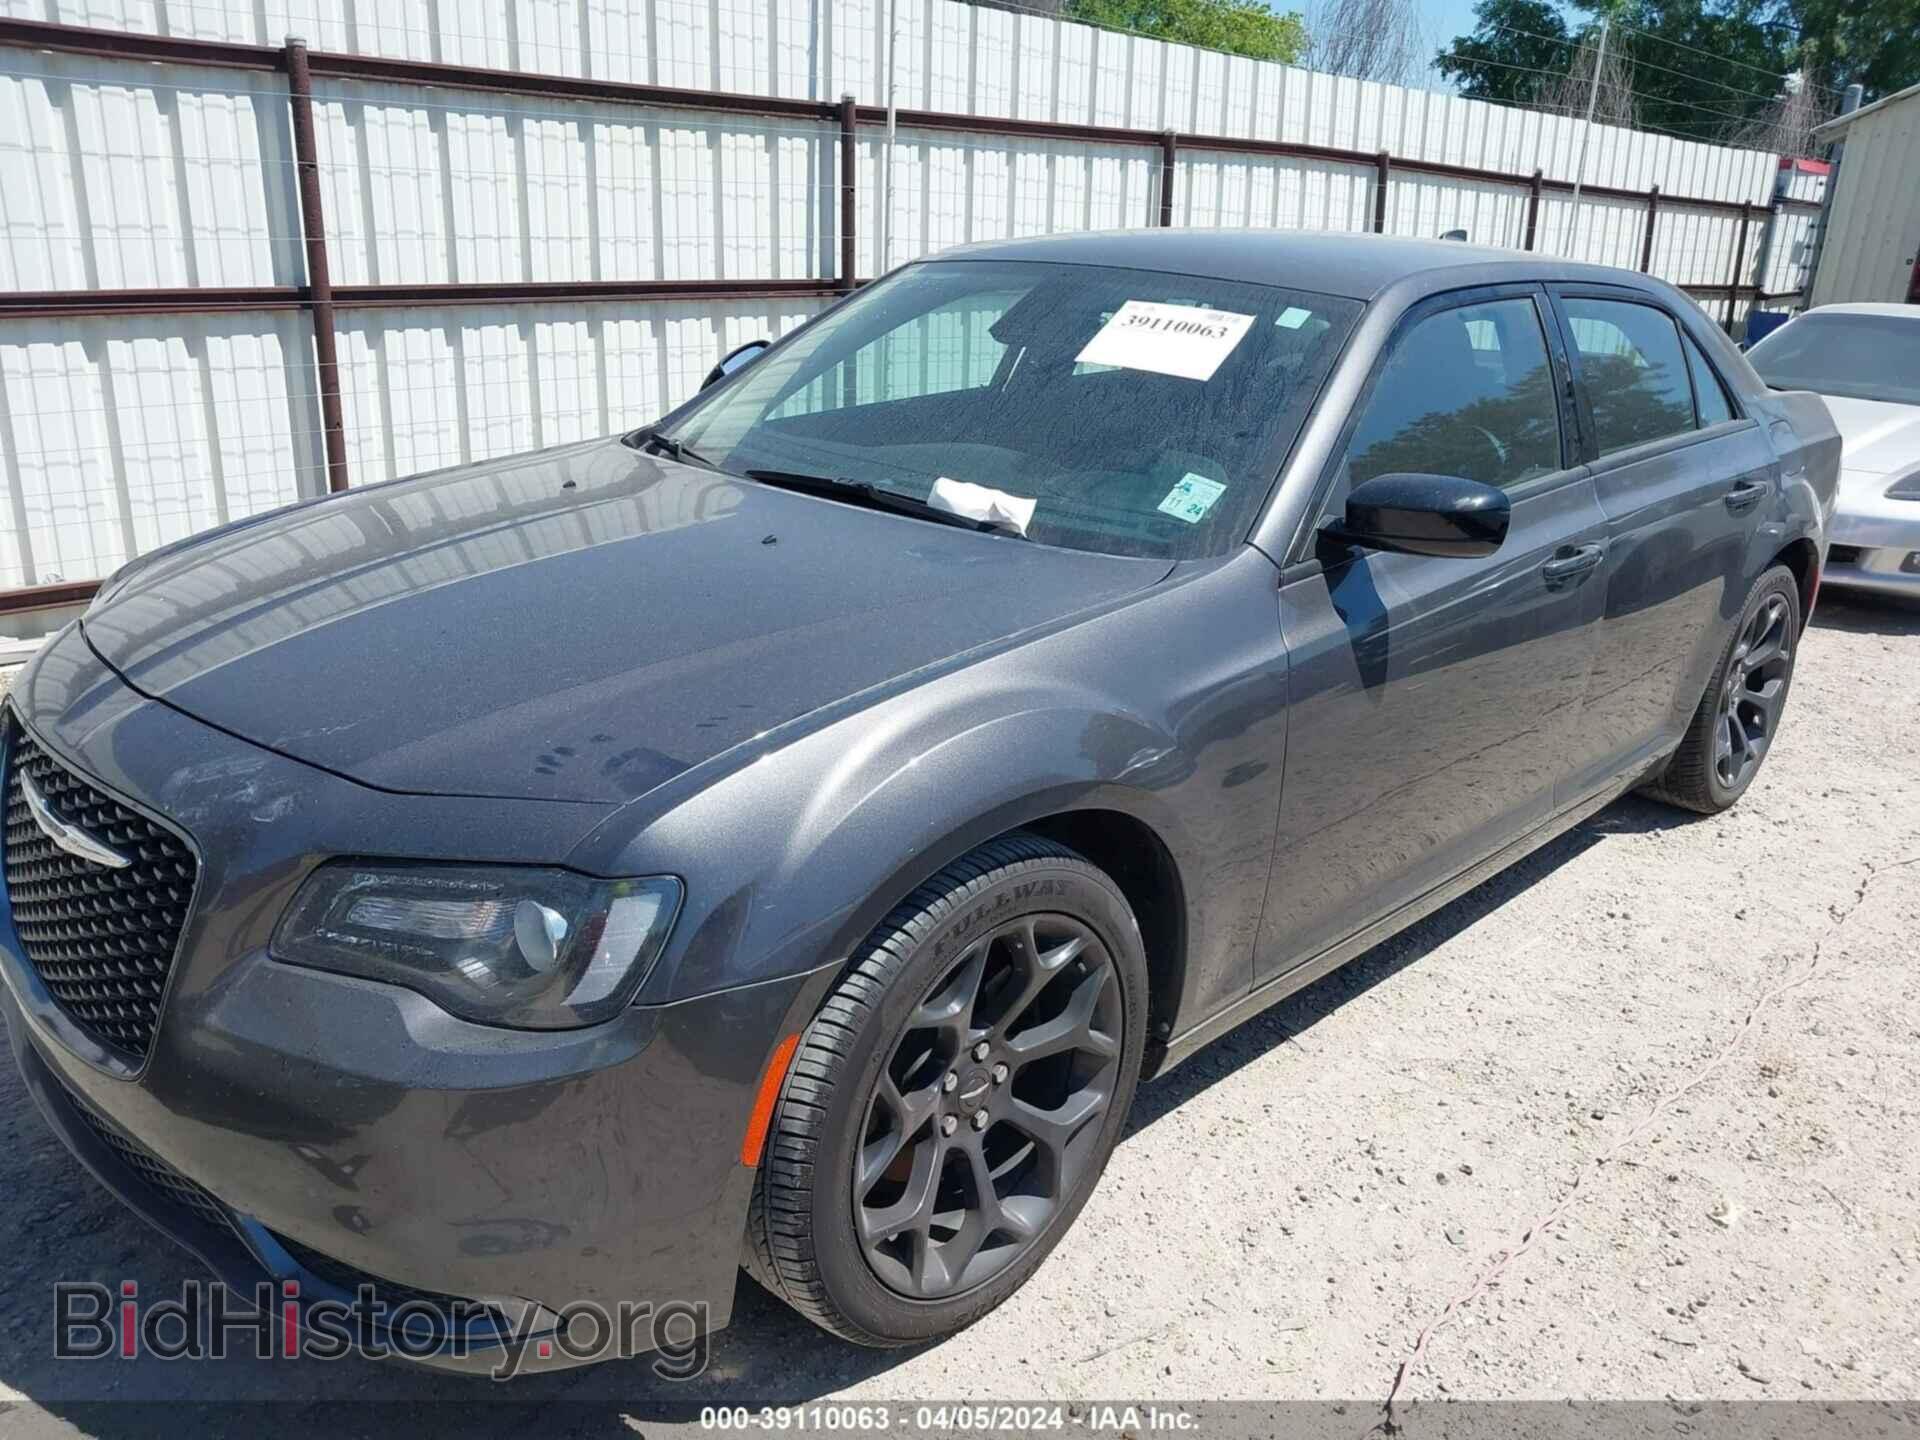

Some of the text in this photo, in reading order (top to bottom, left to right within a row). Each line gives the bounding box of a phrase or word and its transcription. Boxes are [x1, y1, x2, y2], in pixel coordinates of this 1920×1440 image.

[1121, 314, 1229, 339] 39110063
[1186, 503, 1203, 515] 24
[933, 879, 1073, 957] FULLWAY
